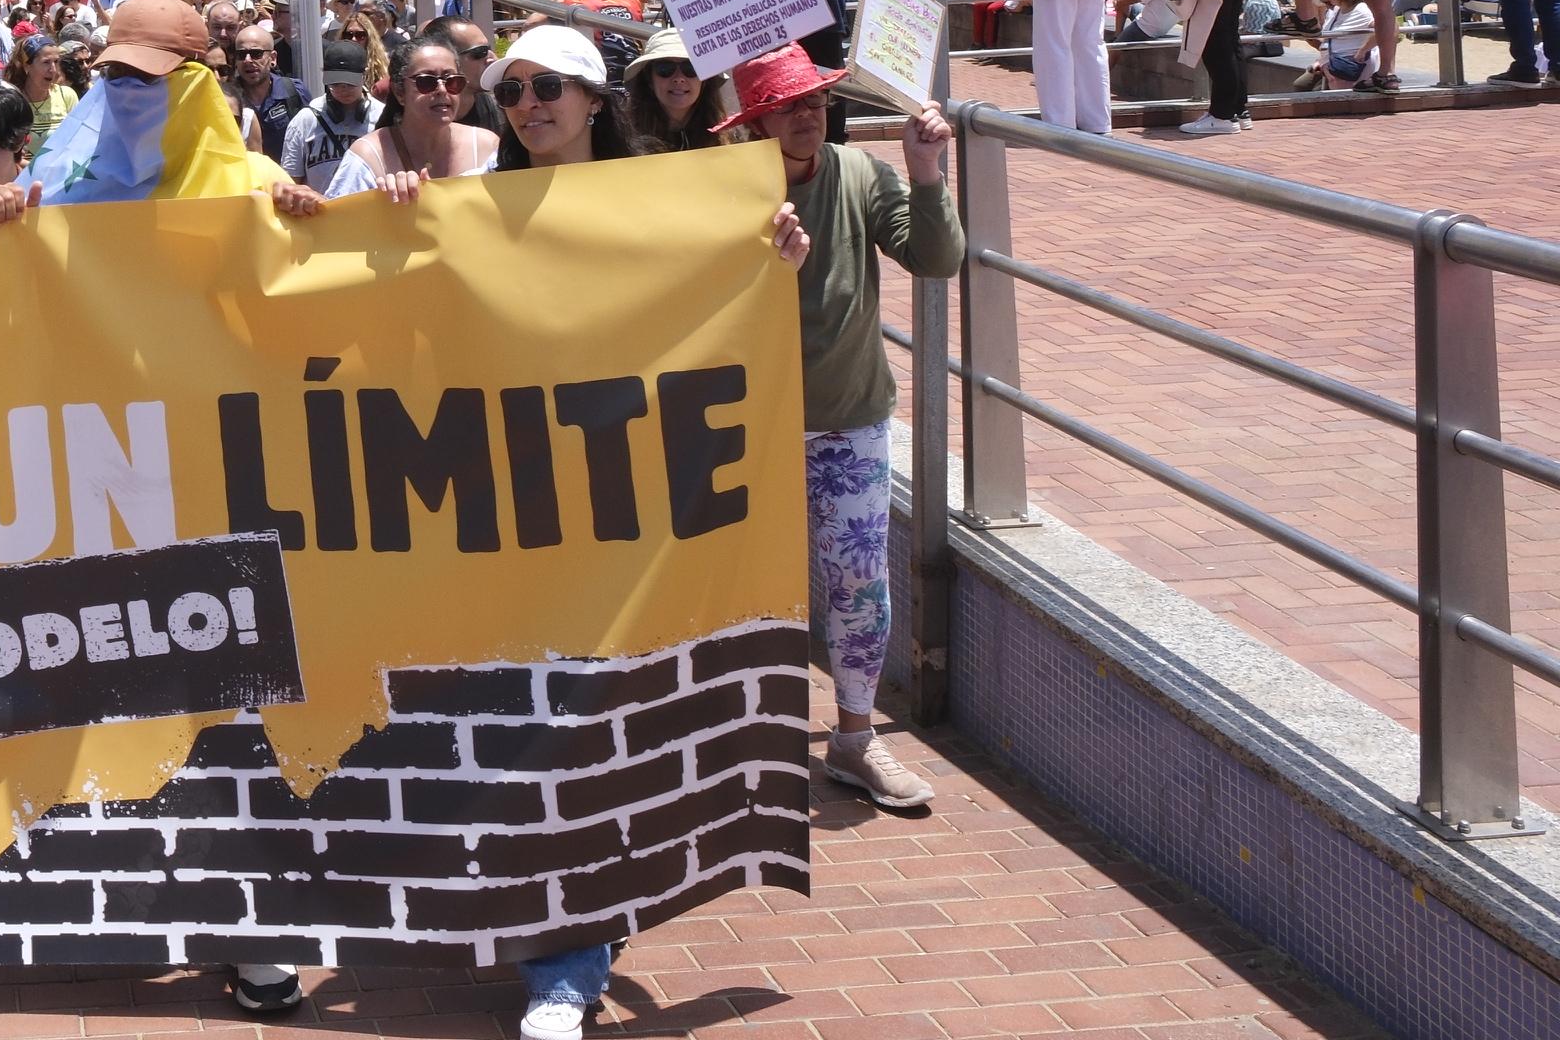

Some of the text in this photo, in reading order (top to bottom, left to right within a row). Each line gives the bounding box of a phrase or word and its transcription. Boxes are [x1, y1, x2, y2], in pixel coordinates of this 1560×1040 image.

[692, 38, 718, 58] CARTA
[718, 34, 729, 47] DE
[729, 27, 743, 42] LOS
[742, 10, 781, 37] DERECHOS
[695, 10, 742, 40] RESIDENCIAS
[736, 25, 788, 57] ARTICULO 25
[218, 356, 749, 553] LÍMITE
